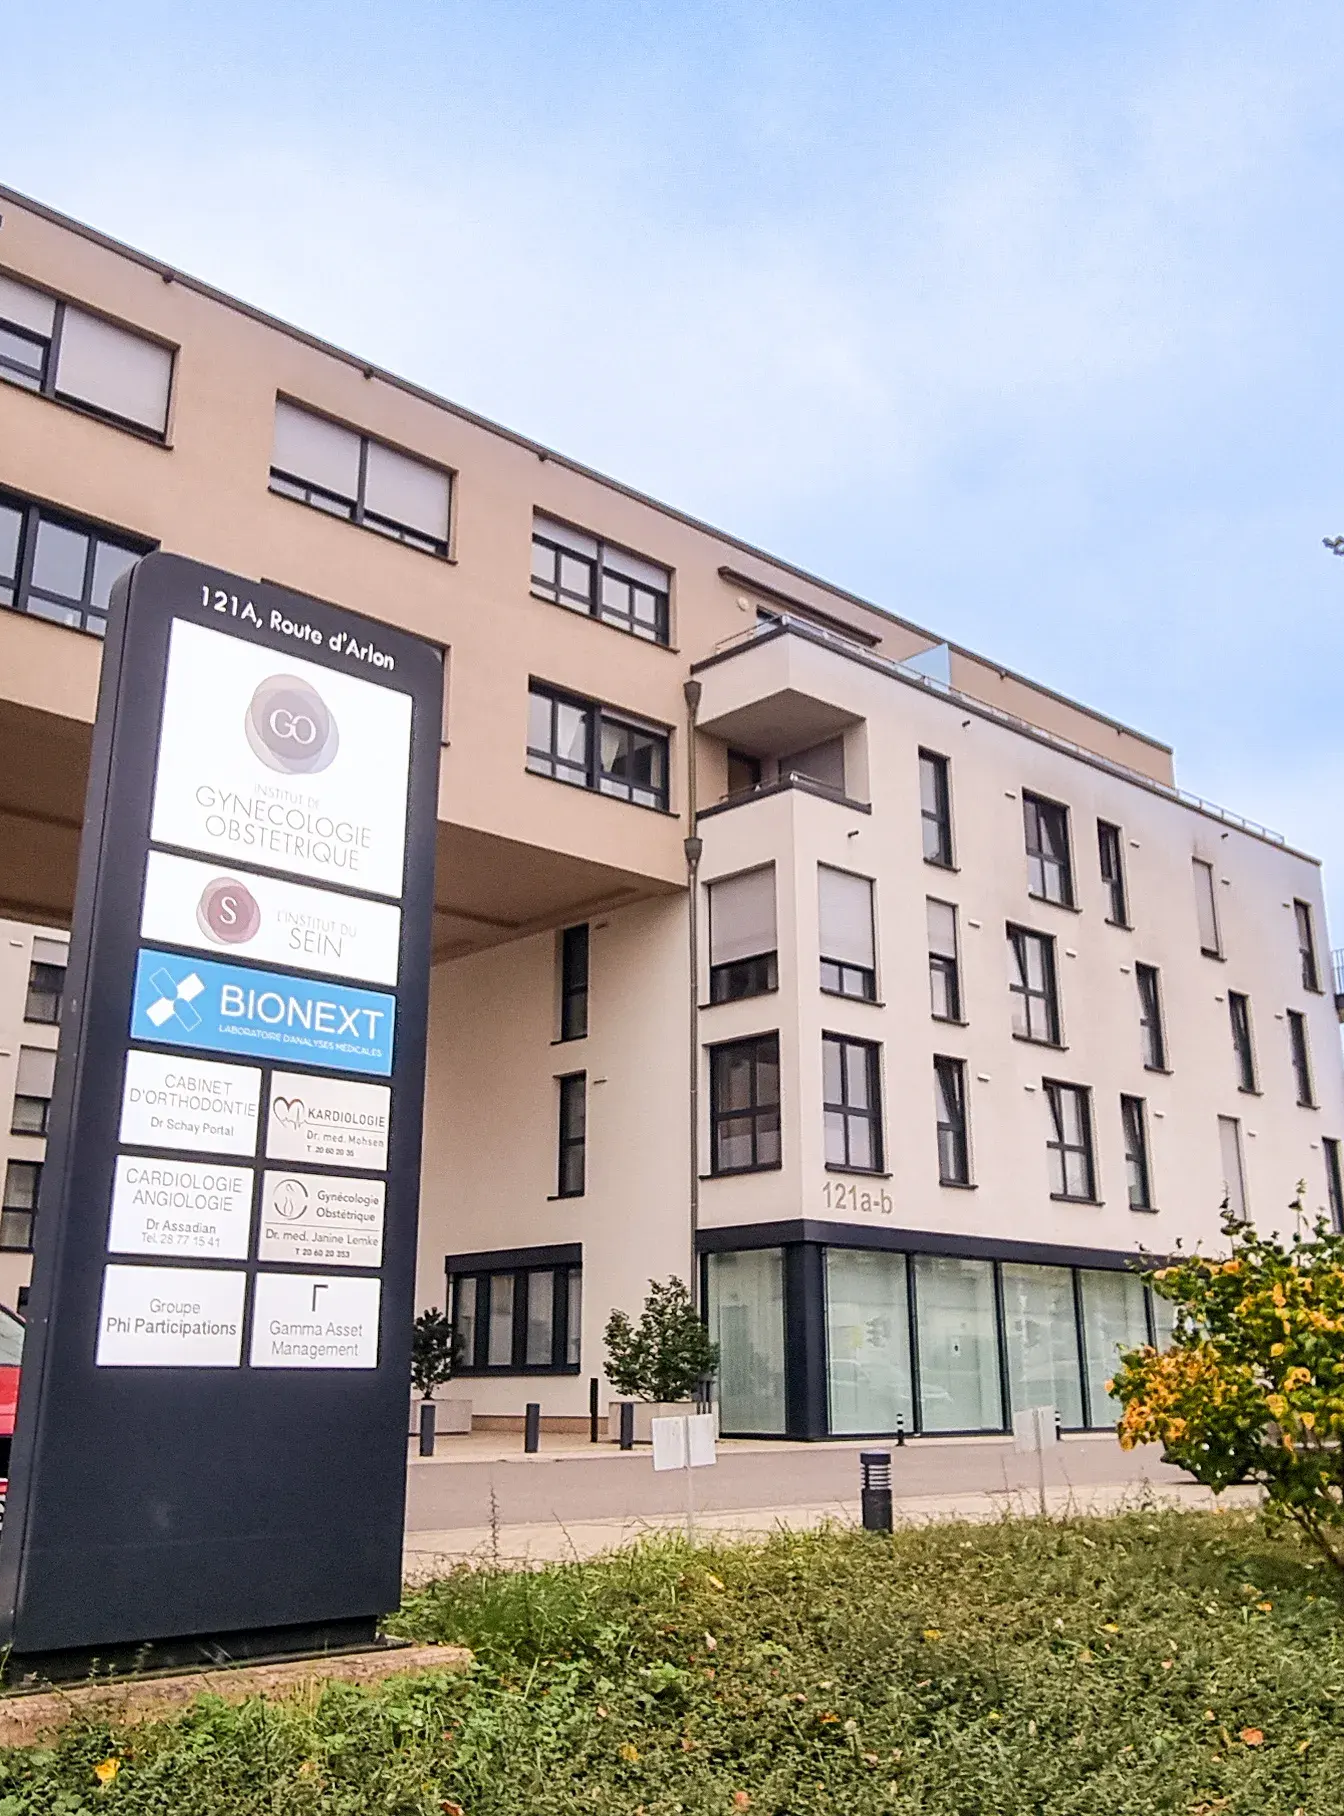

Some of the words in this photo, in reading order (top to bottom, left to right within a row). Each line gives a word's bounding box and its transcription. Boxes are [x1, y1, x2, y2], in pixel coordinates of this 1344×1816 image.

[202, 585, 263, 629] 121A,
[270, 609, 323, 646] Route
[328, 632, 395, 671] d'Arlon
[269, 708, 317, 745] GO
[255, 783, 304, 805] INSTITUT
[307, 796, 320, 810] DE
[195, 785, 372, 849] GYNECOLOGIE
[205, 815, 359, 871] OBSTETRIQUE
[219, 896, 238, 925] S
[340, 923, 357, 938] DU
[288, 927, 343, 958] SEIN
[219, 984, 385, 1041] BIONEXT
[218, 1024, 282, 1043] LABORATOIRE
[164, 1073, 233, 1096] CABINET
[129, 1087, 257, 1118] D'ORTHODONTIE
[150, 1116, 163, 1128] Dr
[166, 1118, 200, 1136] Schay
[202, 1122, 234, 1137] Portal
[307, 1108, 386, 1128] KARDIOLOGIE
[306, 1130, 320, 1141] Dr.
[323, 1134, 346, 1144] med.
[348, 1135, 385, 1148] Mohsen
[126, 1167, 244, 1194] CARDIOLOGIE
[132, 1188, 234, 1212] ANGIOLOGIE
[317, 1189, 380, 1207] Gynécologie
[822, 1181, 893, 1214] 121a-b
[146, 1218, 160, 1230] Dr
[162, 1220, 217, 1234] Assadian
[316, 1207, 376, 1223] Obstétrique
[160, 1233, 174, 1245] 28
[177, 1234, 190, 1245] 77
[207, 1237, 221, 1248] 41
[265, 1228, 280, 1240] Dr.
[283, 1230, 309, 1242] med.
[311, 1232, 344, 1244] Janine
[347, 1234, 379, 1246] Lemke
[149, 1298, 201, 1317] Groupe
[106, 1317, 131, 1333] Phi
[134, 1318, 237, 1339] Participations
[269, 1320, 323, 1336] Gamma
[325, 1321, 363, 1337] Asset
[271, 1340, 359, 1360] Management
